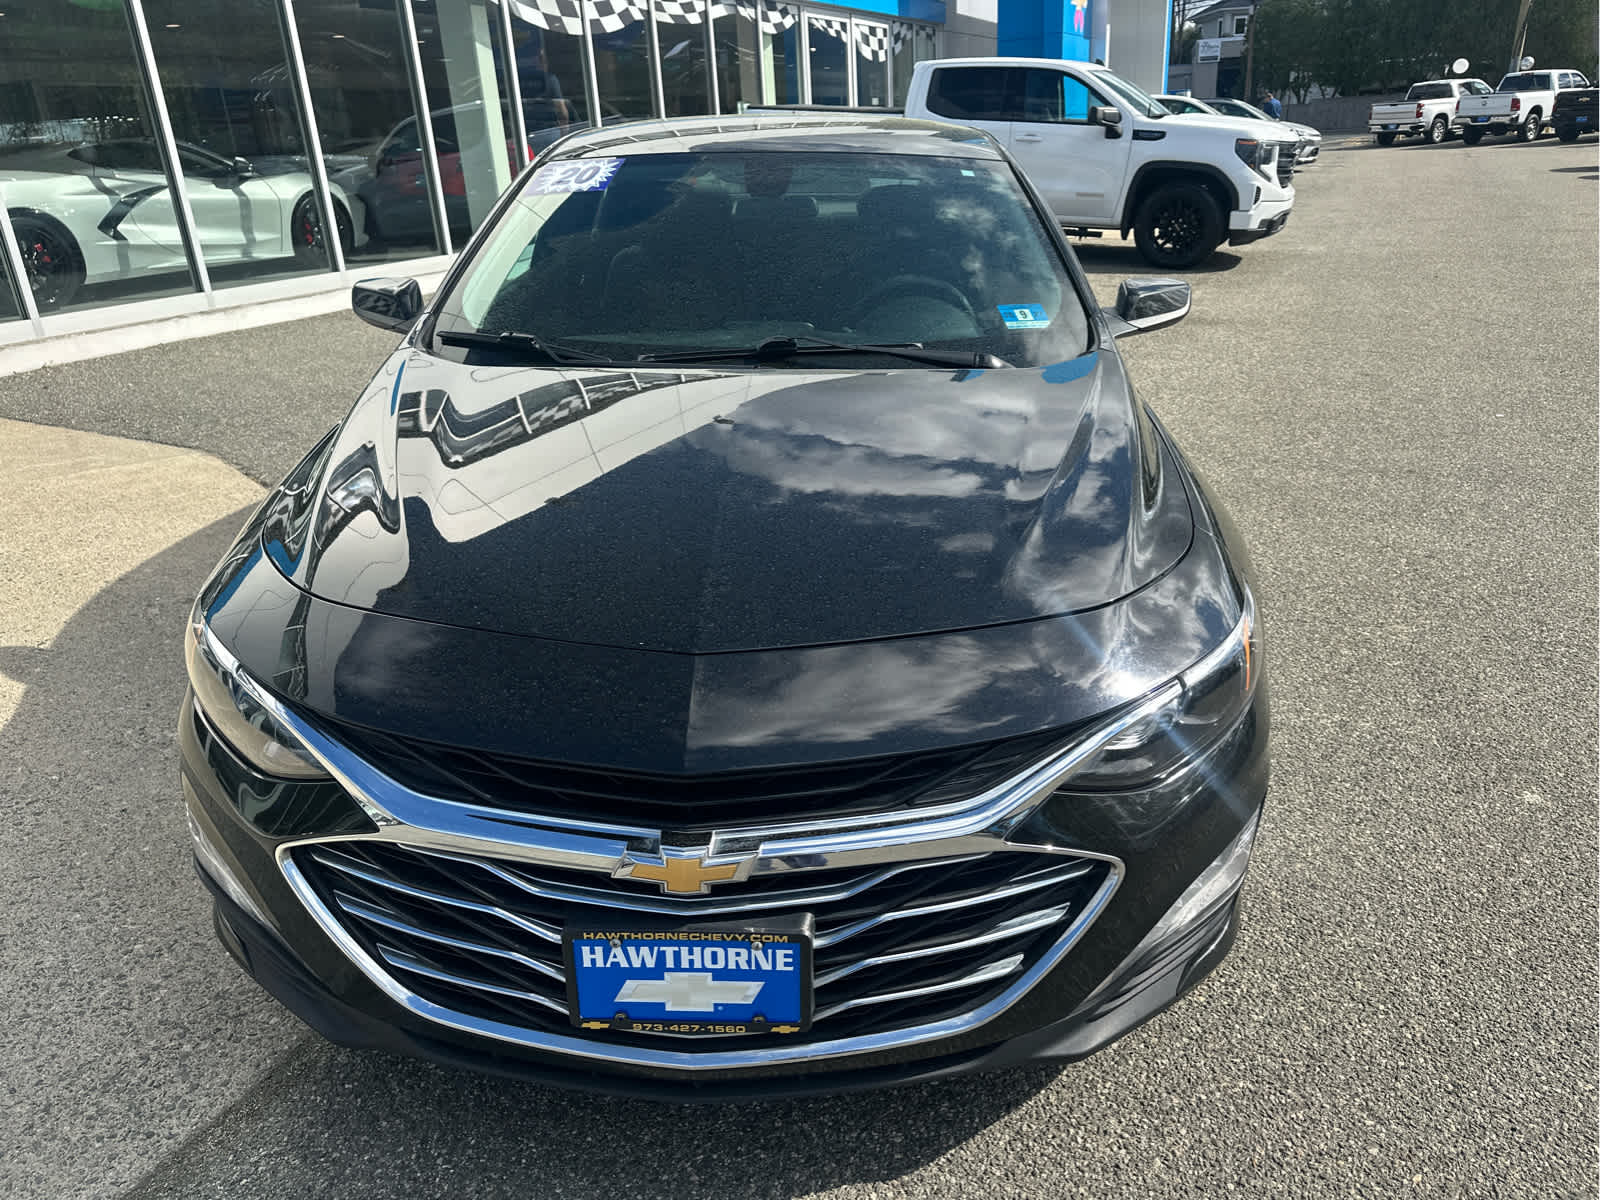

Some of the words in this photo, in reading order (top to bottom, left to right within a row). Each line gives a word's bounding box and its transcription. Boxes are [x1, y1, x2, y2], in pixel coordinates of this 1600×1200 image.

[551, 165, 602, 186] 20
[1019, 310, 1028, 320] 9
[583, 932, 789, 943] HAWTHORNECHEVY.COM
[581, 945, 794, 971] HAWTHORNE
